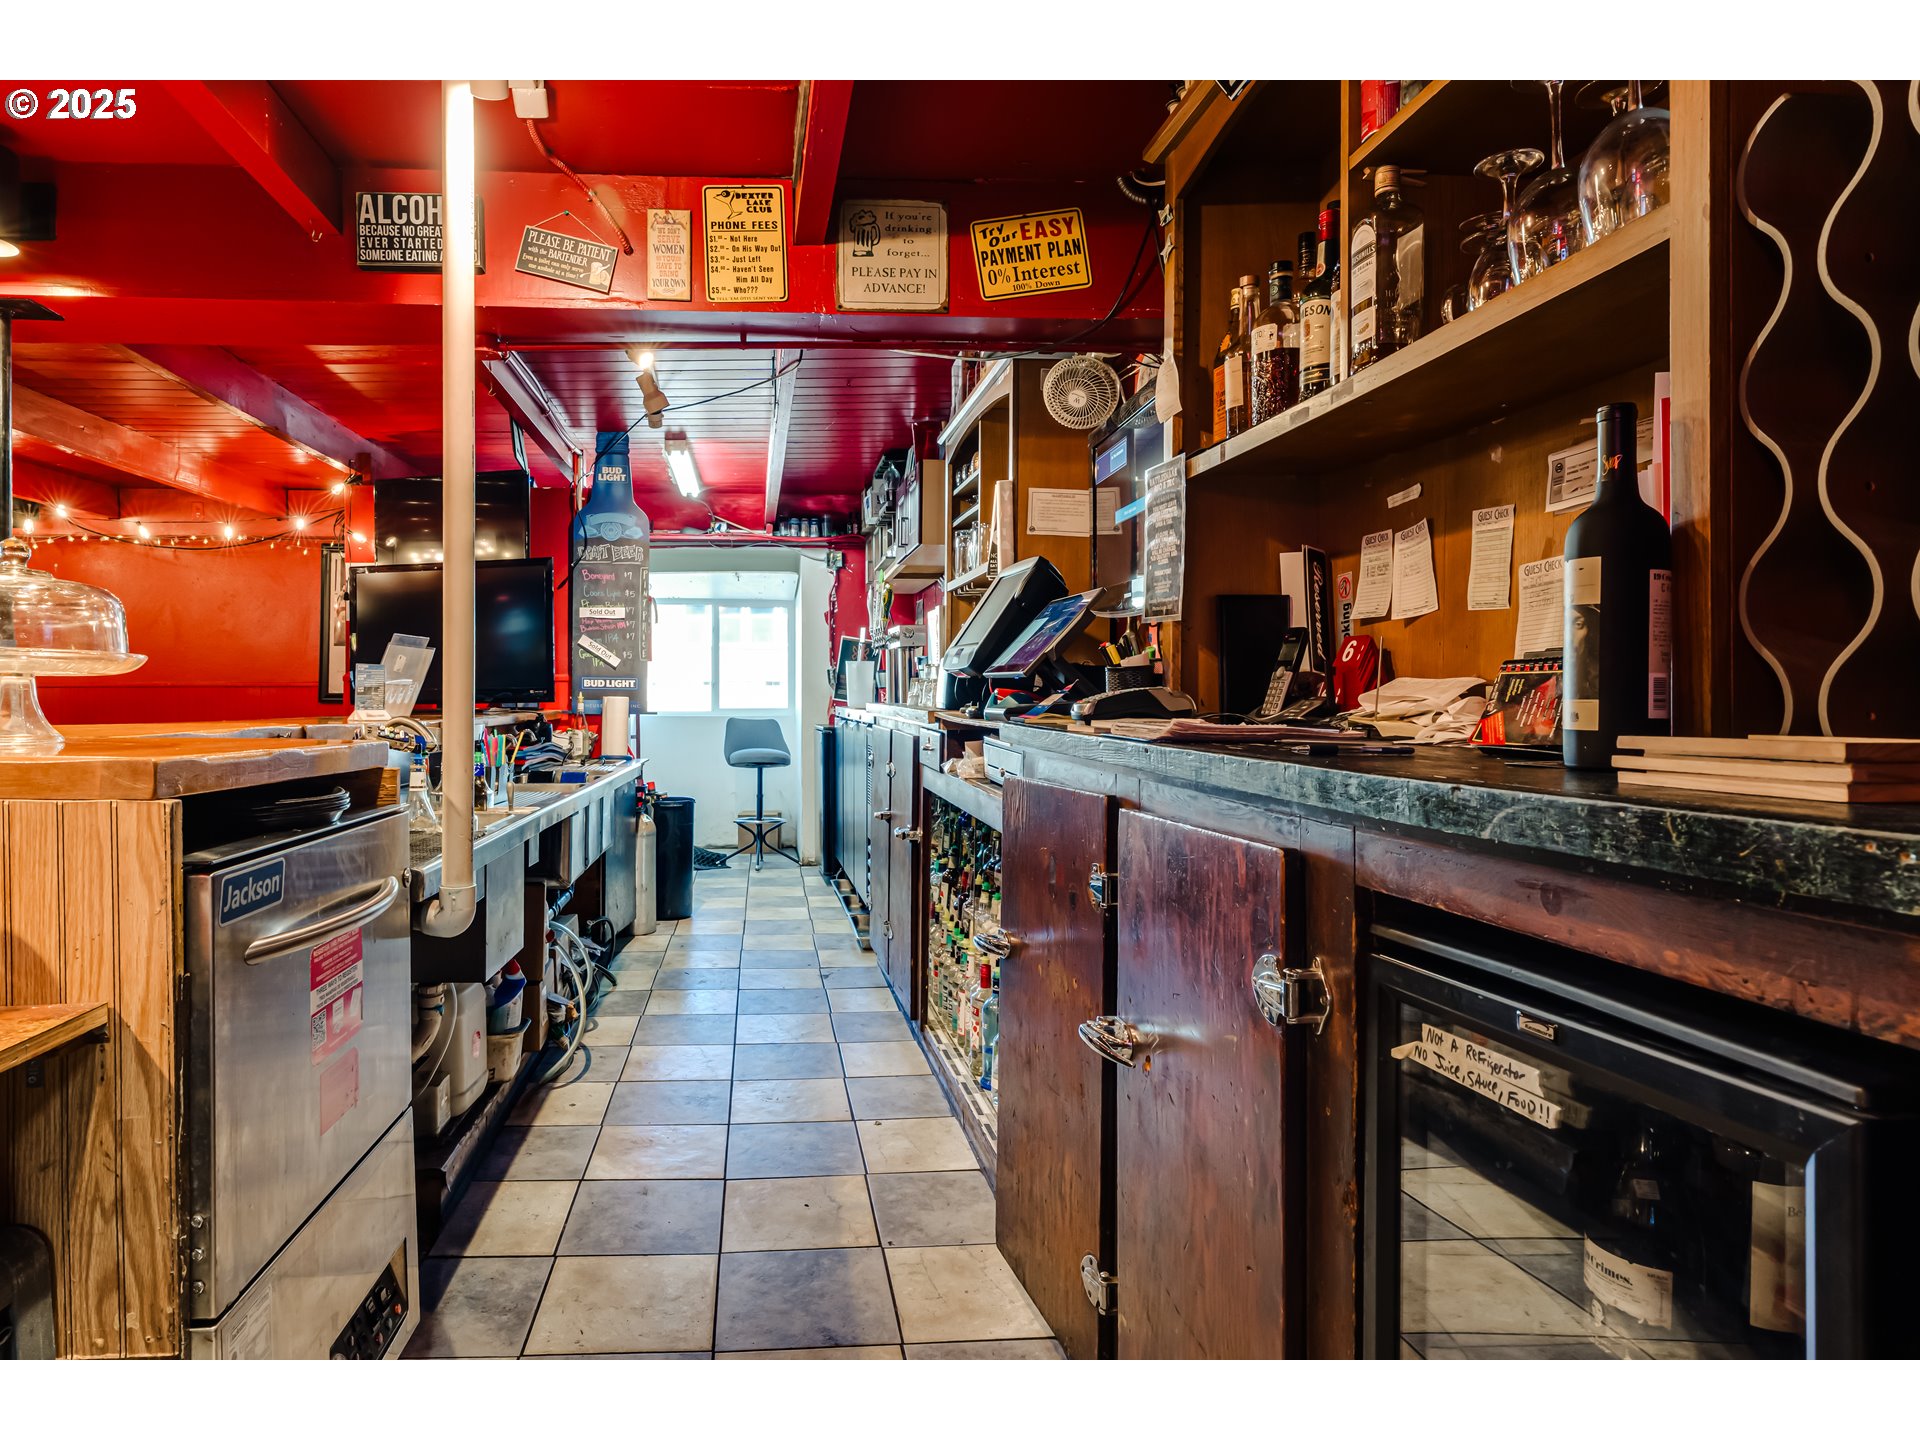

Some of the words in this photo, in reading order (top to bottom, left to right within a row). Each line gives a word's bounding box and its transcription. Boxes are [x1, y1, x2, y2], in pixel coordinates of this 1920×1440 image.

[360, 195, 443, 224] ALCOH
[885, 211, 893, 219] If
[898, 211, 932, 221] you're
[360, 225, 400, 236] BECAUSE
[402, 226, 415, 236] NO
[711, 221, 746, 229] PHONE
[752, 221, 778, 229] FEES
[884, 224, 932, 234] drinking
[979, 223, 1004, 239] Try
[989, 230, 1018, 247] Our
[1019, 216, 1074, 240] EASY
[360, 237, 388, 248] EVER
[657, 234, 680, 243] SERVE
[528, 230, 561, 249] PLEASE
[563, 239, 575, 253] BE
[577, 242, 612, 261] PATIENT
[653, 244, 685, 254] WOMEN
[755, 245, 768, 253] Way
[360, 250, 404, 261] SOMEONE
[406, 250, 438, 261] EATING
[522, 252, 533, 261] Even
[548, 248, 588, 267] BARTENDER
[887, 248, 930, 259] forget...
[980, 243, 1041, 267] PAYMENT
[1047, 238, 1082, 258] PLAN
[732, 255, 746, 263] Just
[748, 255, 761, 263] Left
[851, 266, 896, 278] PLEASE
[899, 267, 921, 278] PAY
[925, 268, 937, 278] IN
[987, 268, 1011, 285] 0%
[1012, 260, 1081, 282] Interest
[652, 278, 669, 287] YOUR
[670, 279, 686, 288] OWN
[761, 276, 773, 284] Day
[1012, 282, 1032, 291] 100%
[1035, 280, 1061, 289] Down
[733, 286, 759, 294] Who???
[863, 282, 926, 293] ADVANCE!
[601, 466, 623, 474] BUD
[598, 473, 626, 482] LIGHT
[1477, 510, 1493, 522] GUEST
[1494, 508, 1510, 520] CHECK
[611, 544, 644, 561] BEER
[624, 571, 633, 580] $7
[1523, 563, 1542, 577] GUEST
[624, 589, 636, 598] $5
[1313, 561, 1327, 660] Reserved
[626, 632, 635, 641] $7
[588, 641, 601, 652] Sold
[601, 650, 612, 660] Out
[1342, 640, 1357, 662] 6
[606, 680, 636, 688] LIGHT
[223, 874, 282, 913] Jackson
[1450, 1039, 1459, 1053] A
